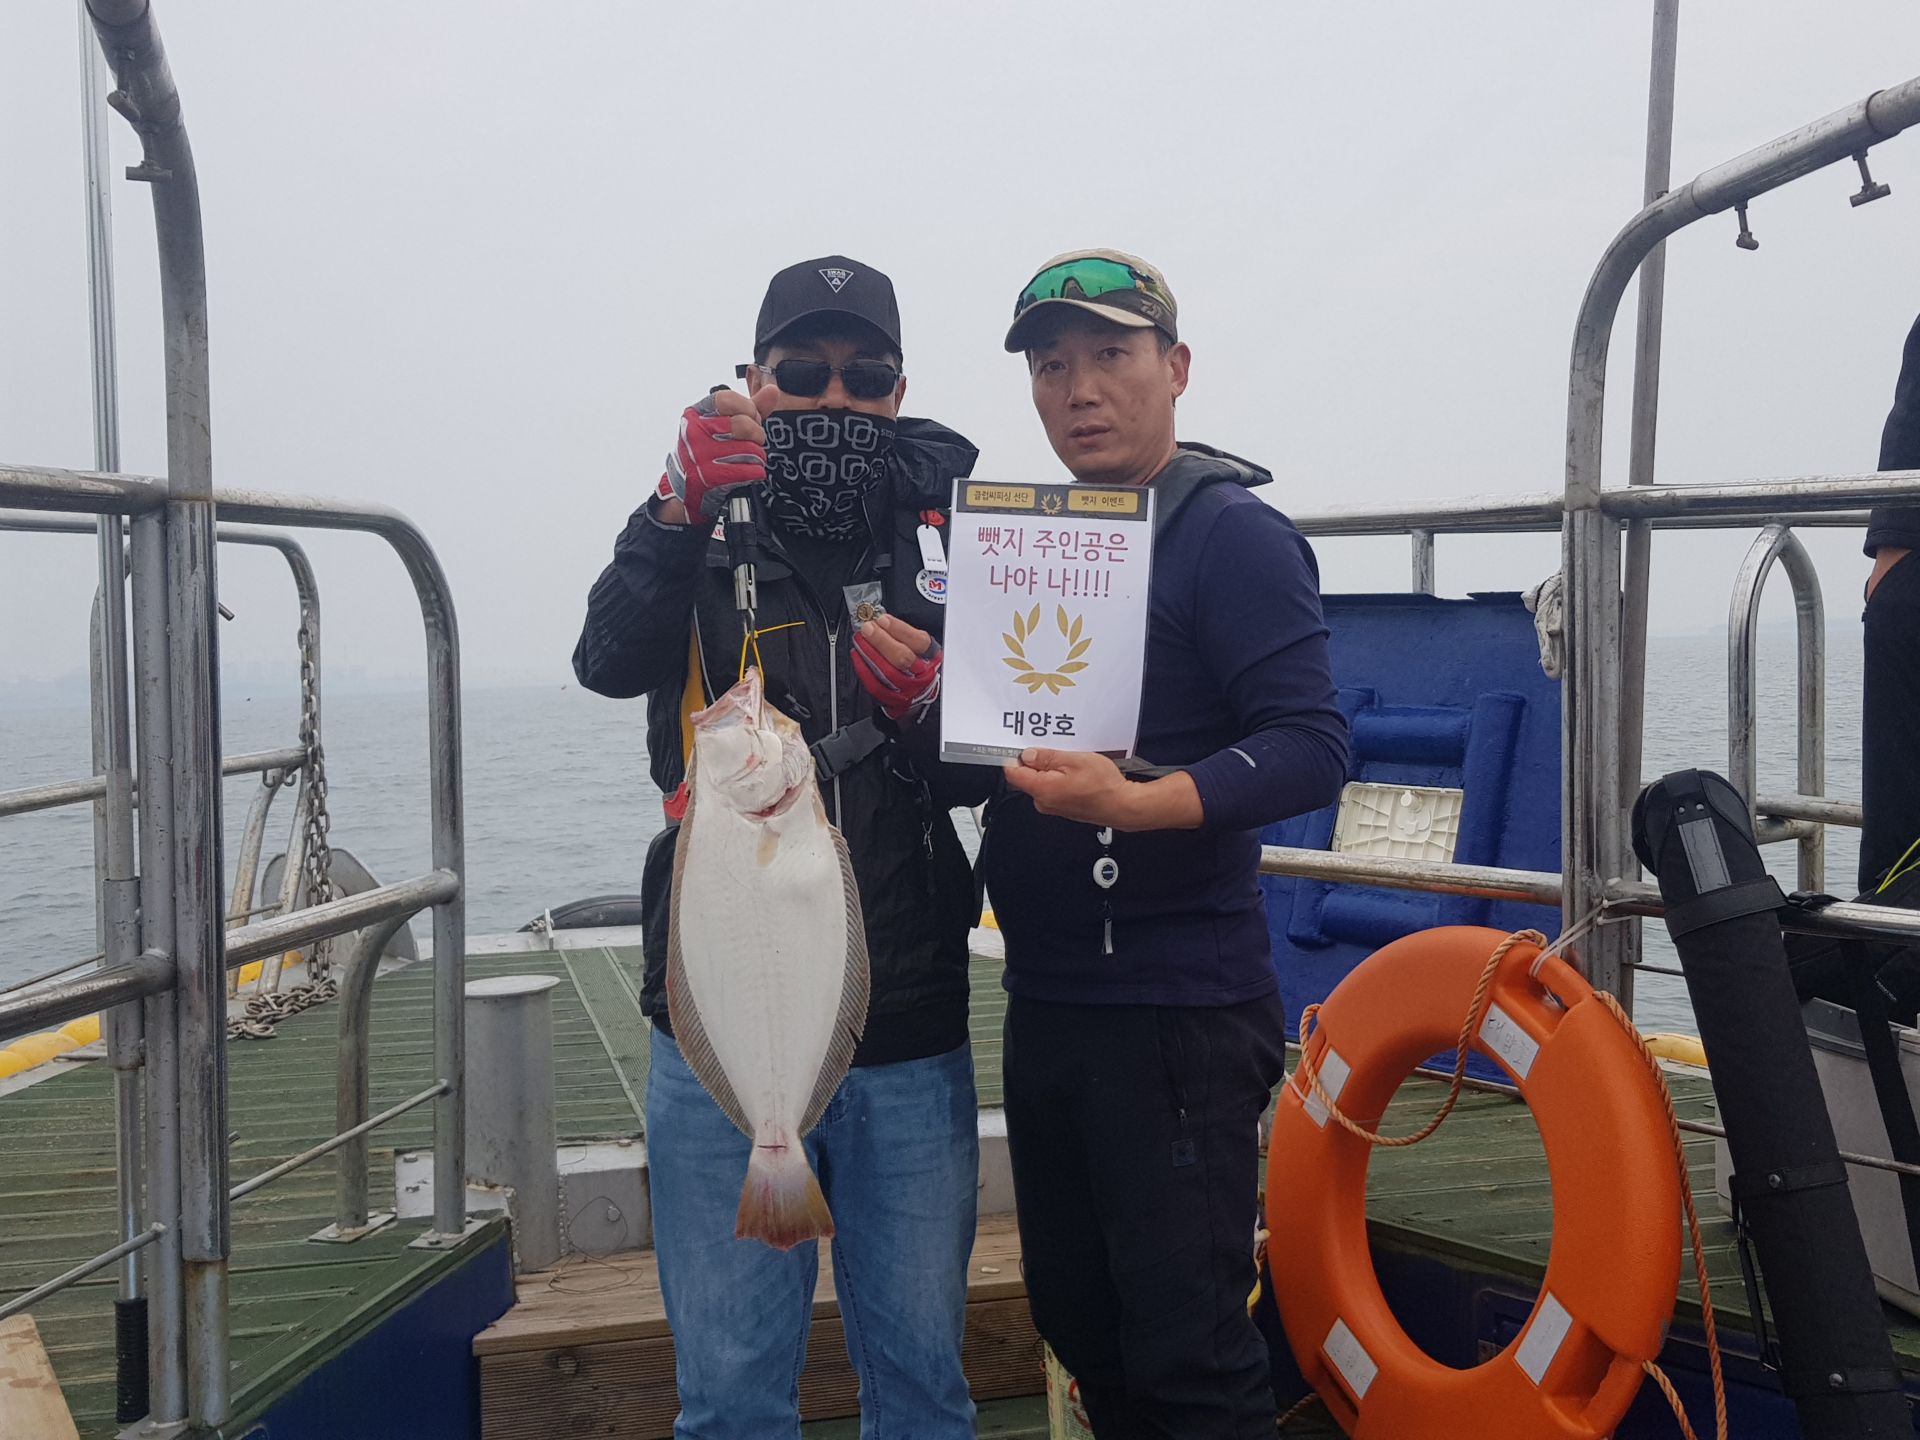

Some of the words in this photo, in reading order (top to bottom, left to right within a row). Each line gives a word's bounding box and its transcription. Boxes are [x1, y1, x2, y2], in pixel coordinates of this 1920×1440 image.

[1014, 492, 1029, 503] 선단
[1101, 496, 1126, 508] 이벤트
[978, 526, 1023, 557] 뺏지
[1033, 530, 1128, 562] 주인공은
[990, 565, 1038, 595] 나야
[1047, 568, 1110, 597] 나!!!!
[1003, 710, 1076, 737] 대양호
